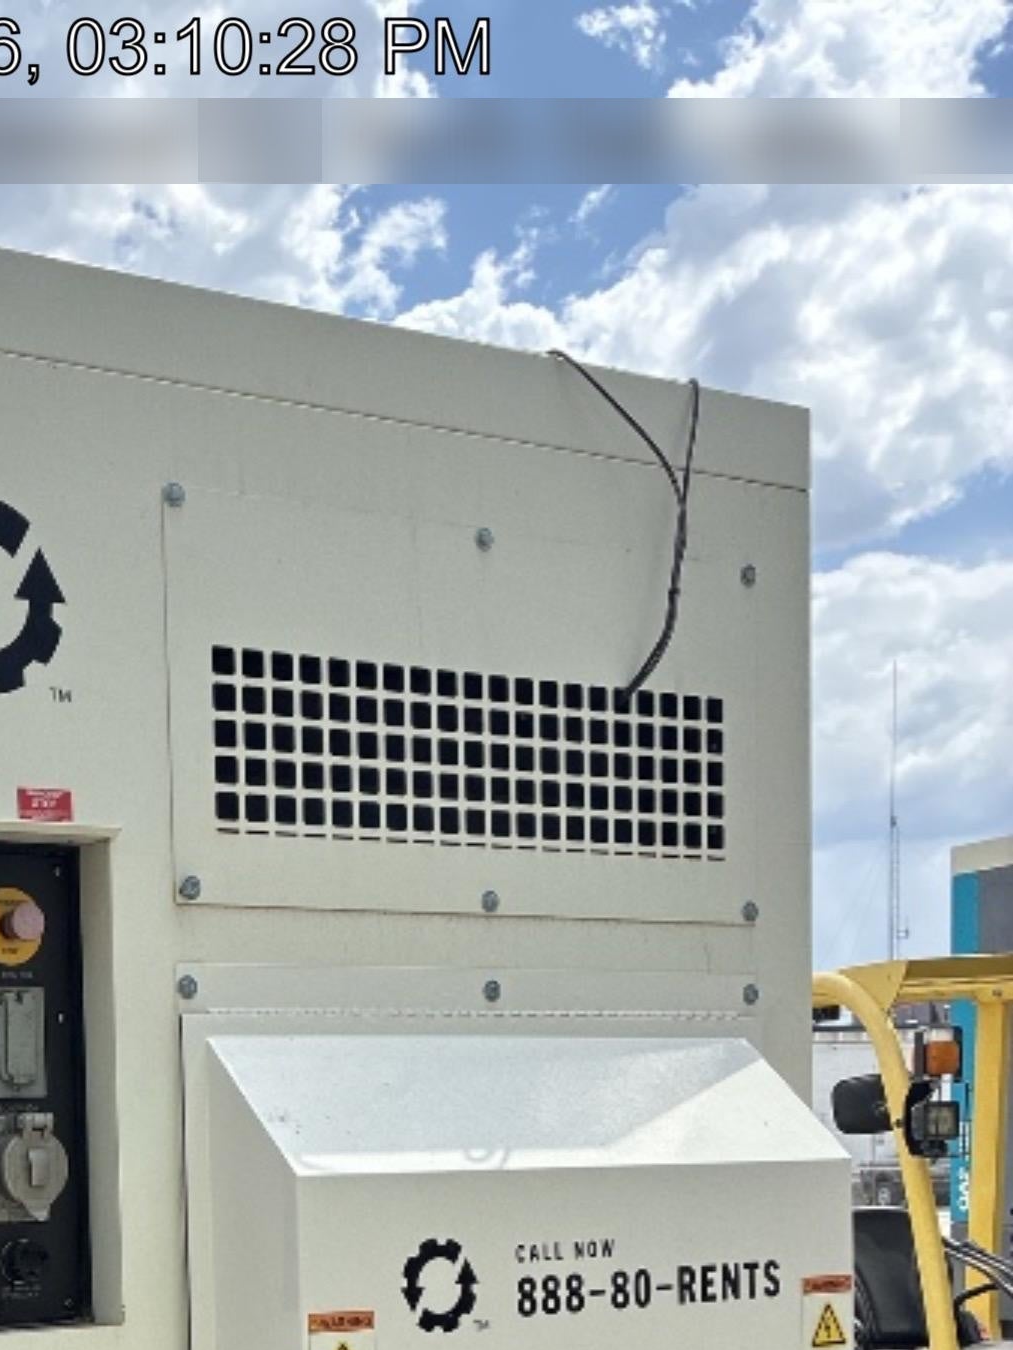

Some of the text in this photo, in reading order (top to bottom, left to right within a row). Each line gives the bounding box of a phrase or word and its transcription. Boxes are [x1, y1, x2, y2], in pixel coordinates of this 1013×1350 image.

[515, 1239, 615, 1264] CALL NOW
[517, 1260, 781, 1317] 888-80-RENTS
